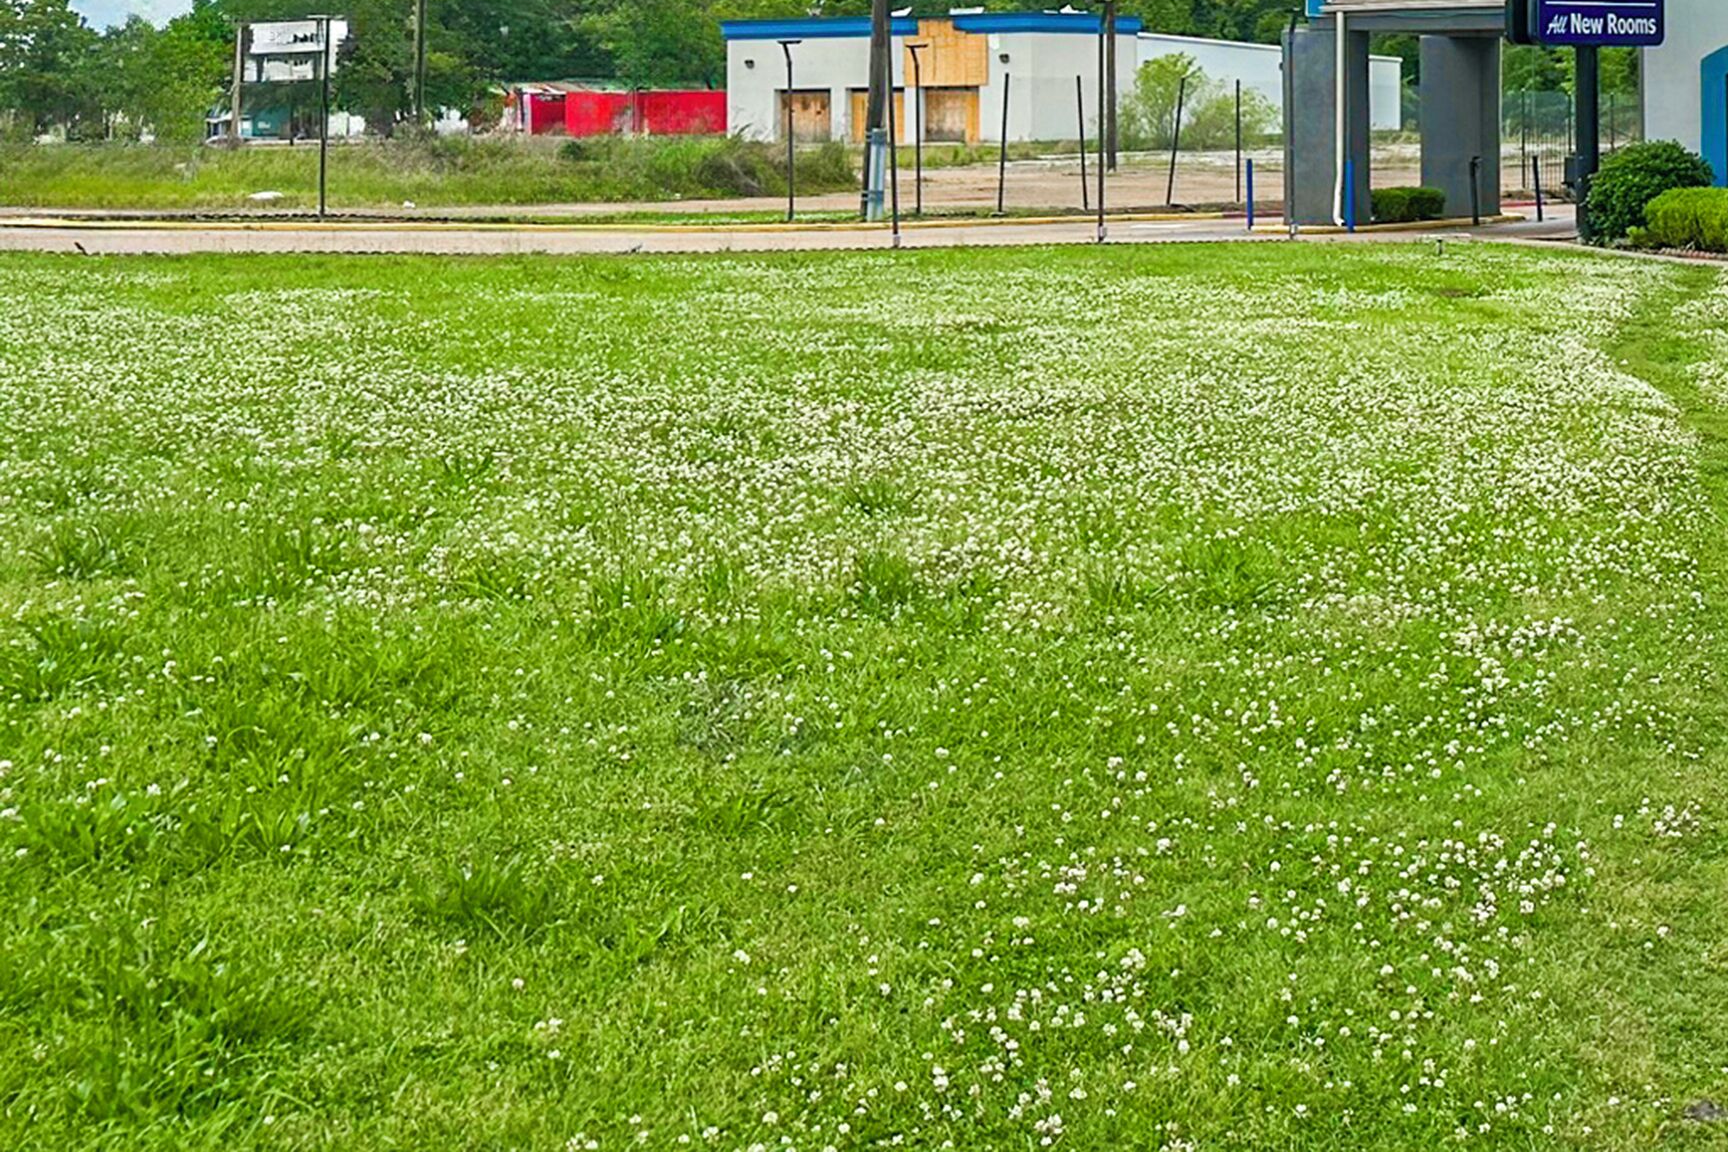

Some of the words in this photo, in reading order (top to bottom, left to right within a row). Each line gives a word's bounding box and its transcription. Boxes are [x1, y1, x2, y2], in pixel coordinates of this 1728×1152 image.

[1546, 13, 1569, 35] All
[1570, 12, 1604, 35] New
[1607, 12, 1657, 35] Rooms
